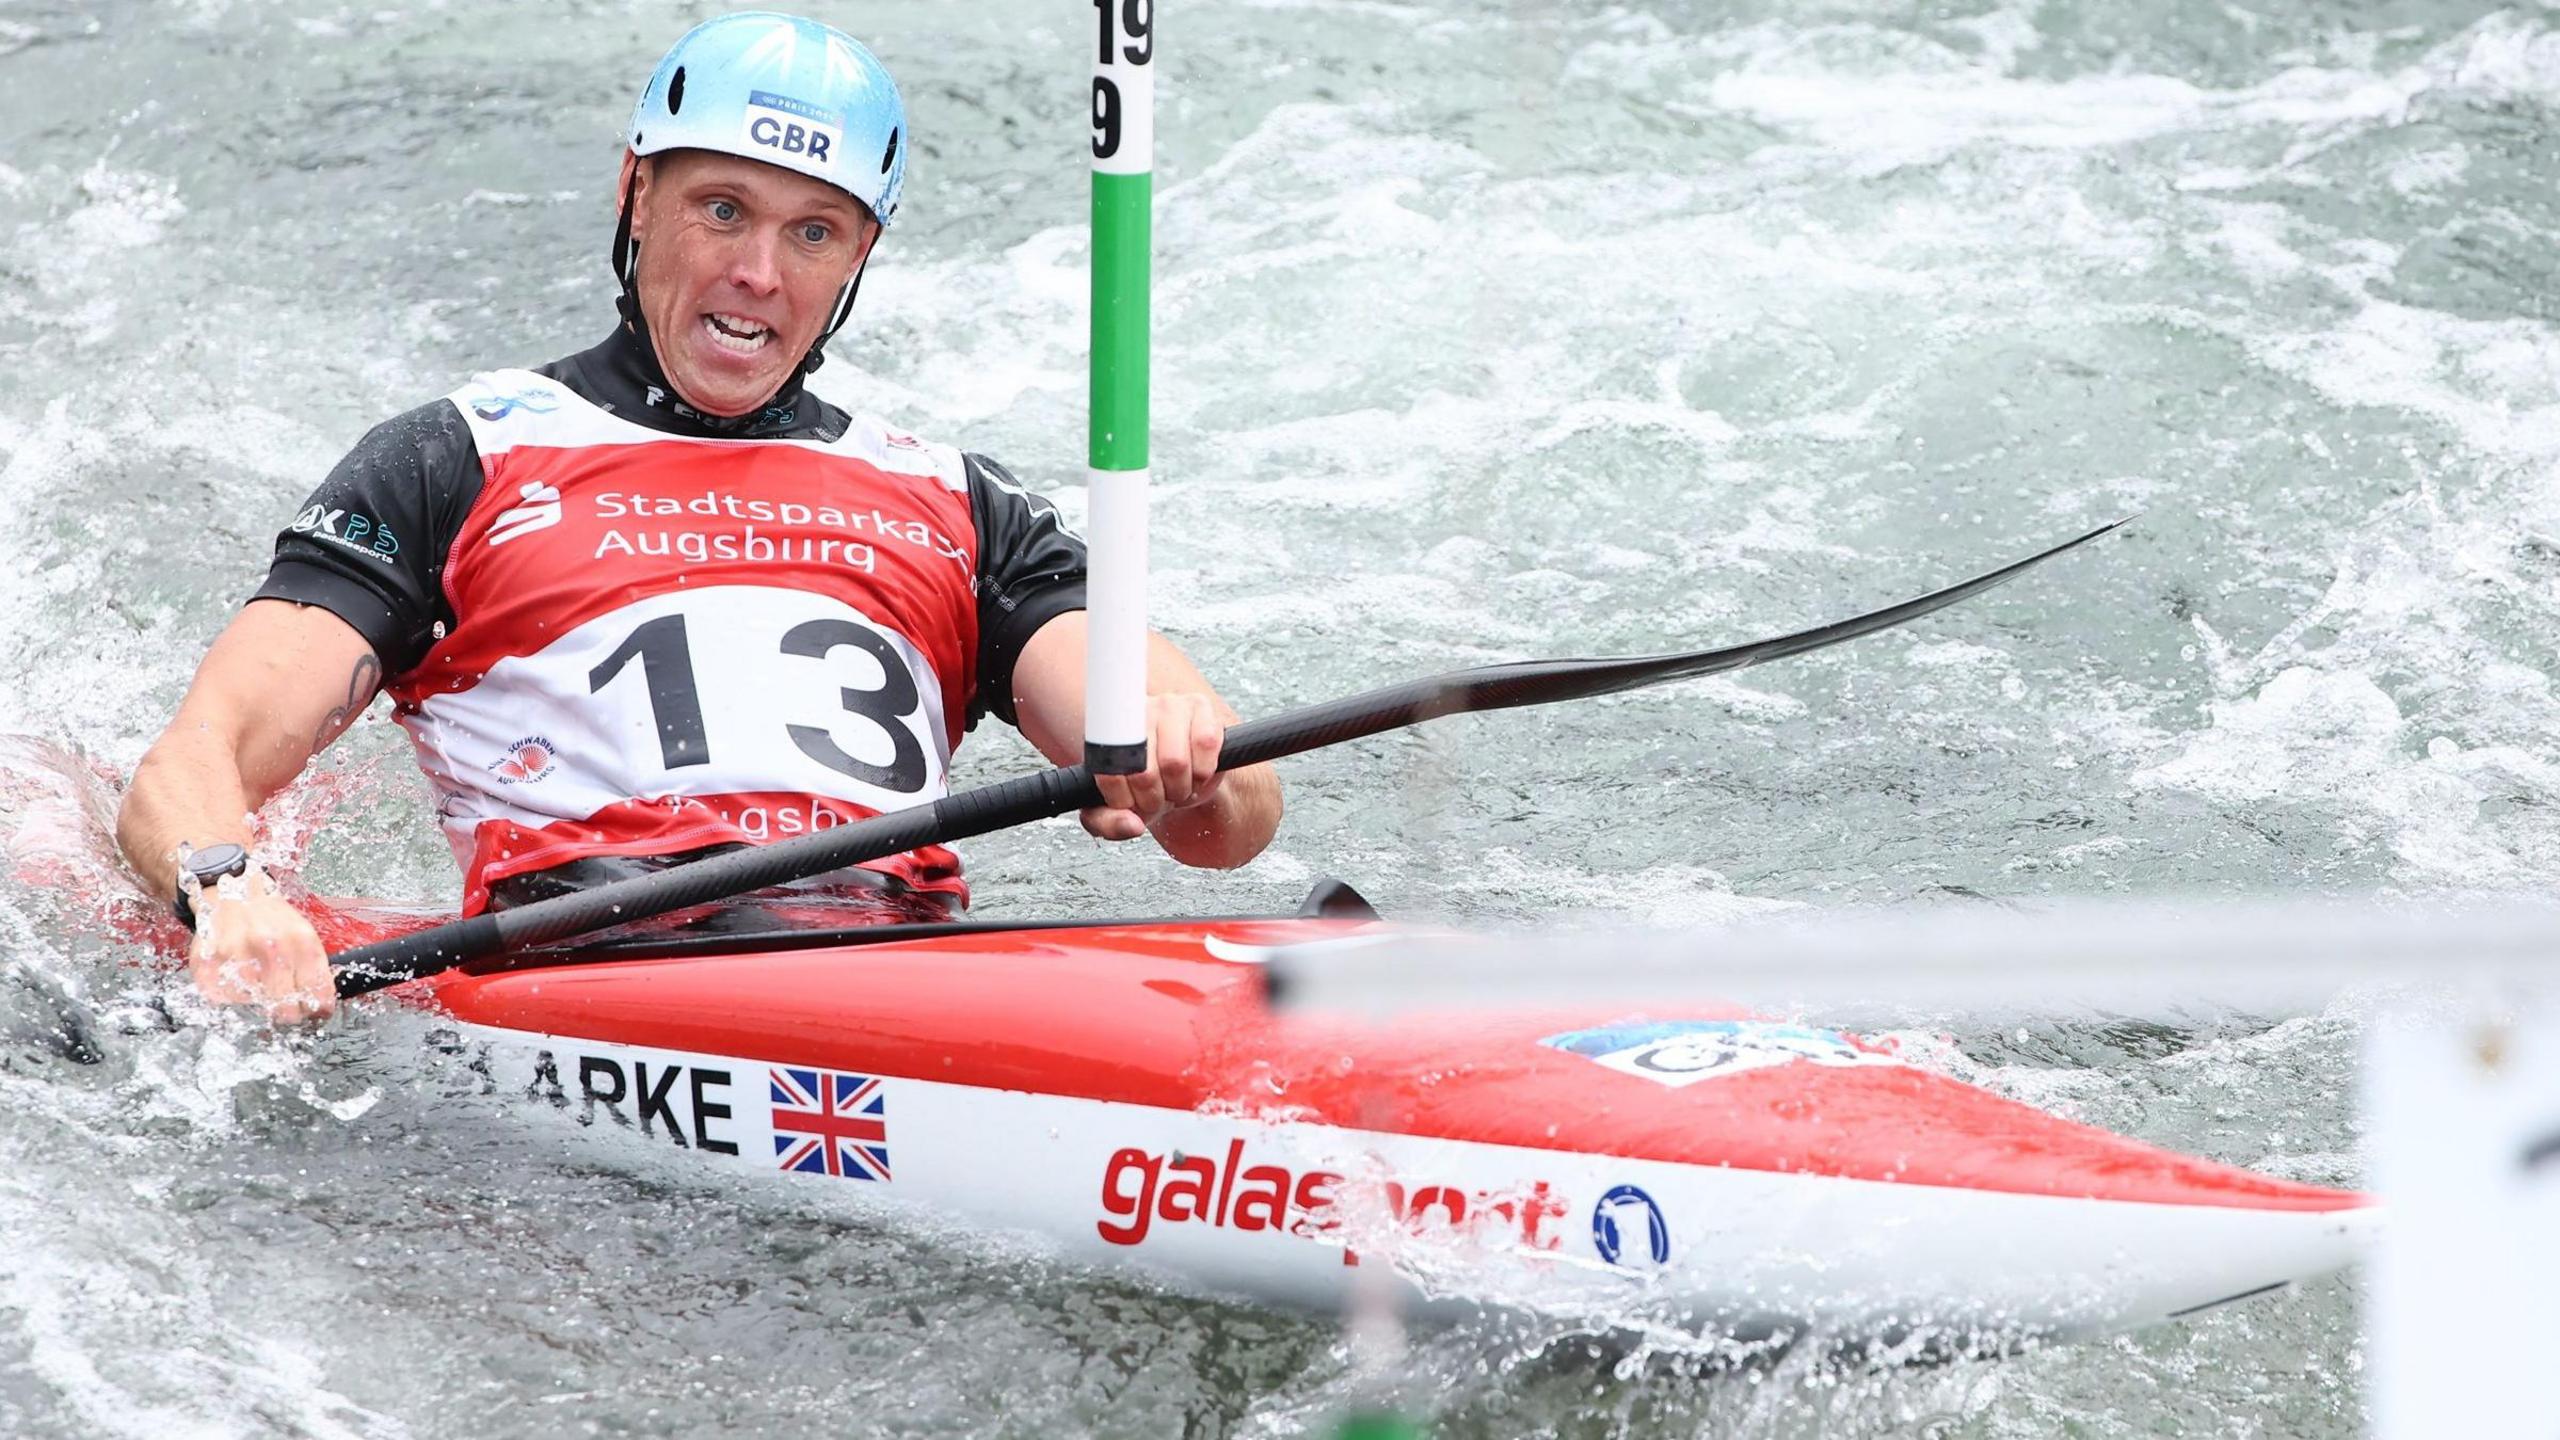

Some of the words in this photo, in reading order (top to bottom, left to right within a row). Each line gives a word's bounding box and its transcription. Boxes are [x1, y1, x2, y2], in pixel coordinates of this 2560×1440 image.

[750, 117, 831, 163] GBR
[594, 525, 877, 574] Augsburg
[589, 613, 928, 794] 13
[508, 736, 556, 756] SCHWABEN
